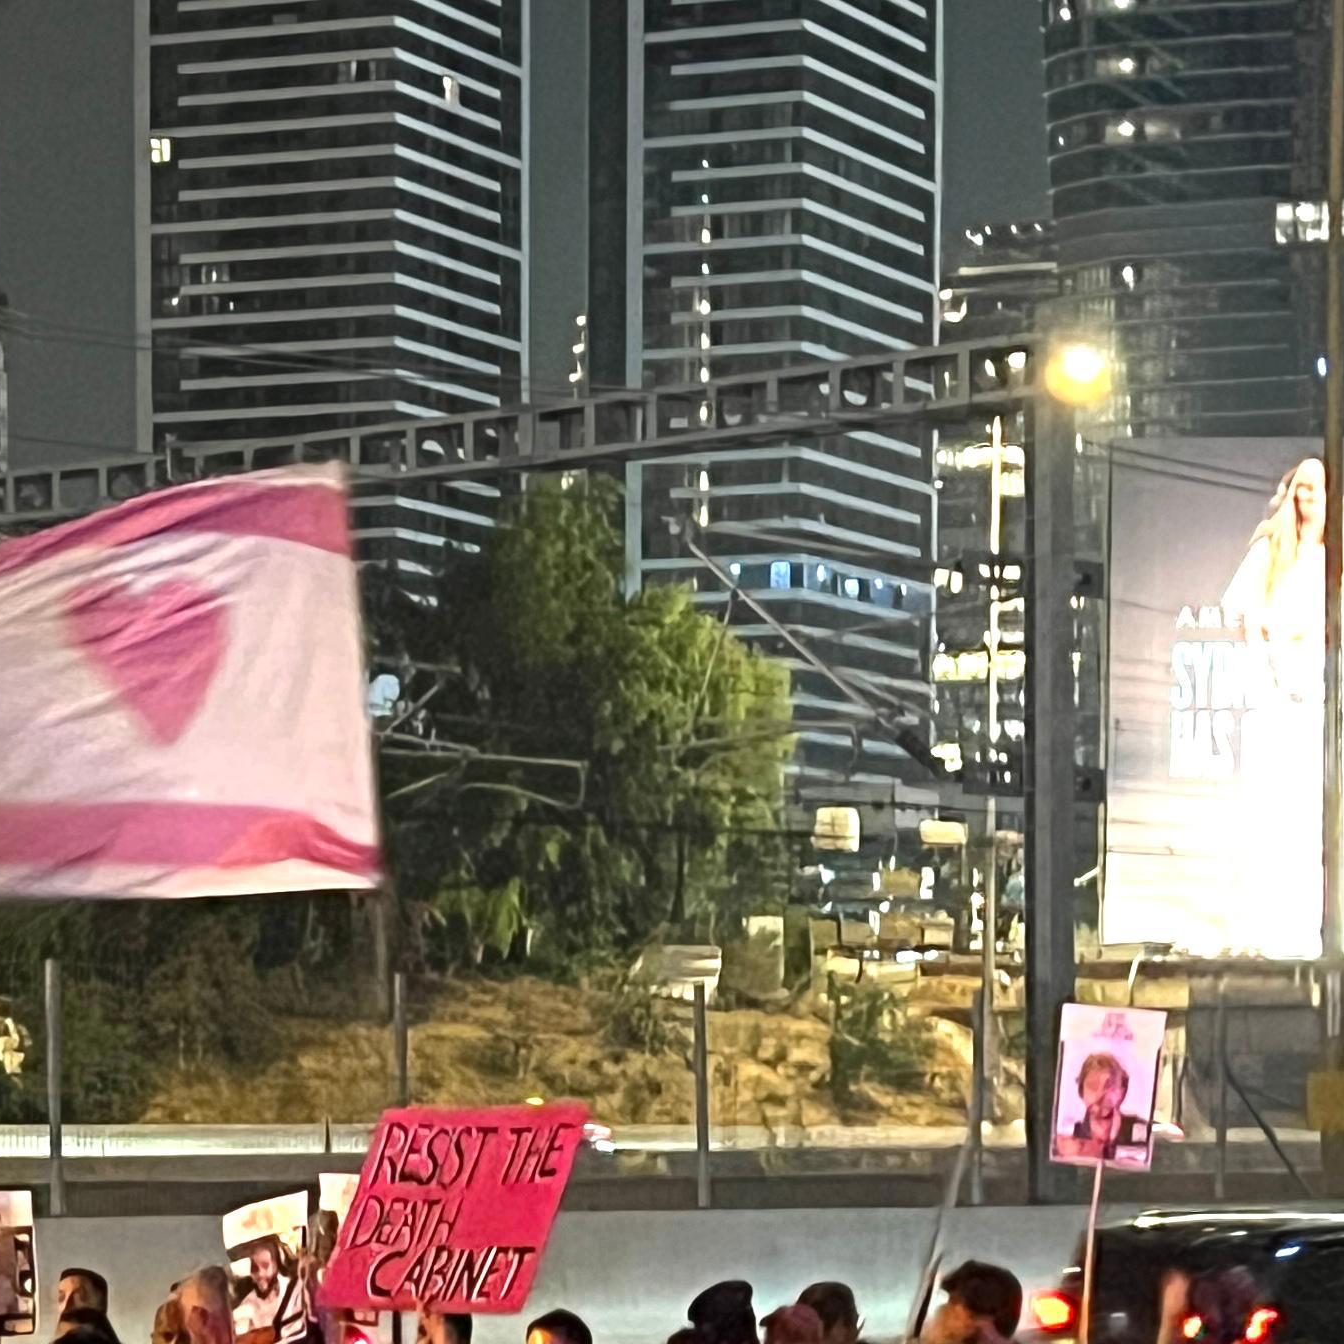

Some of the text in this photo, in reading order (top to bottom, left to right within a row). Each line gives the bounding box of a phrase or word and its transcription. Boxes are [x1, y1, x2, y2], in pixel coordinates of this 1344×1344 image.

[500, 1122, 577, 1185] THE
[345, 1194, 464, 1252] DEATH
[367, 1244, 536, 1302] CABINET
